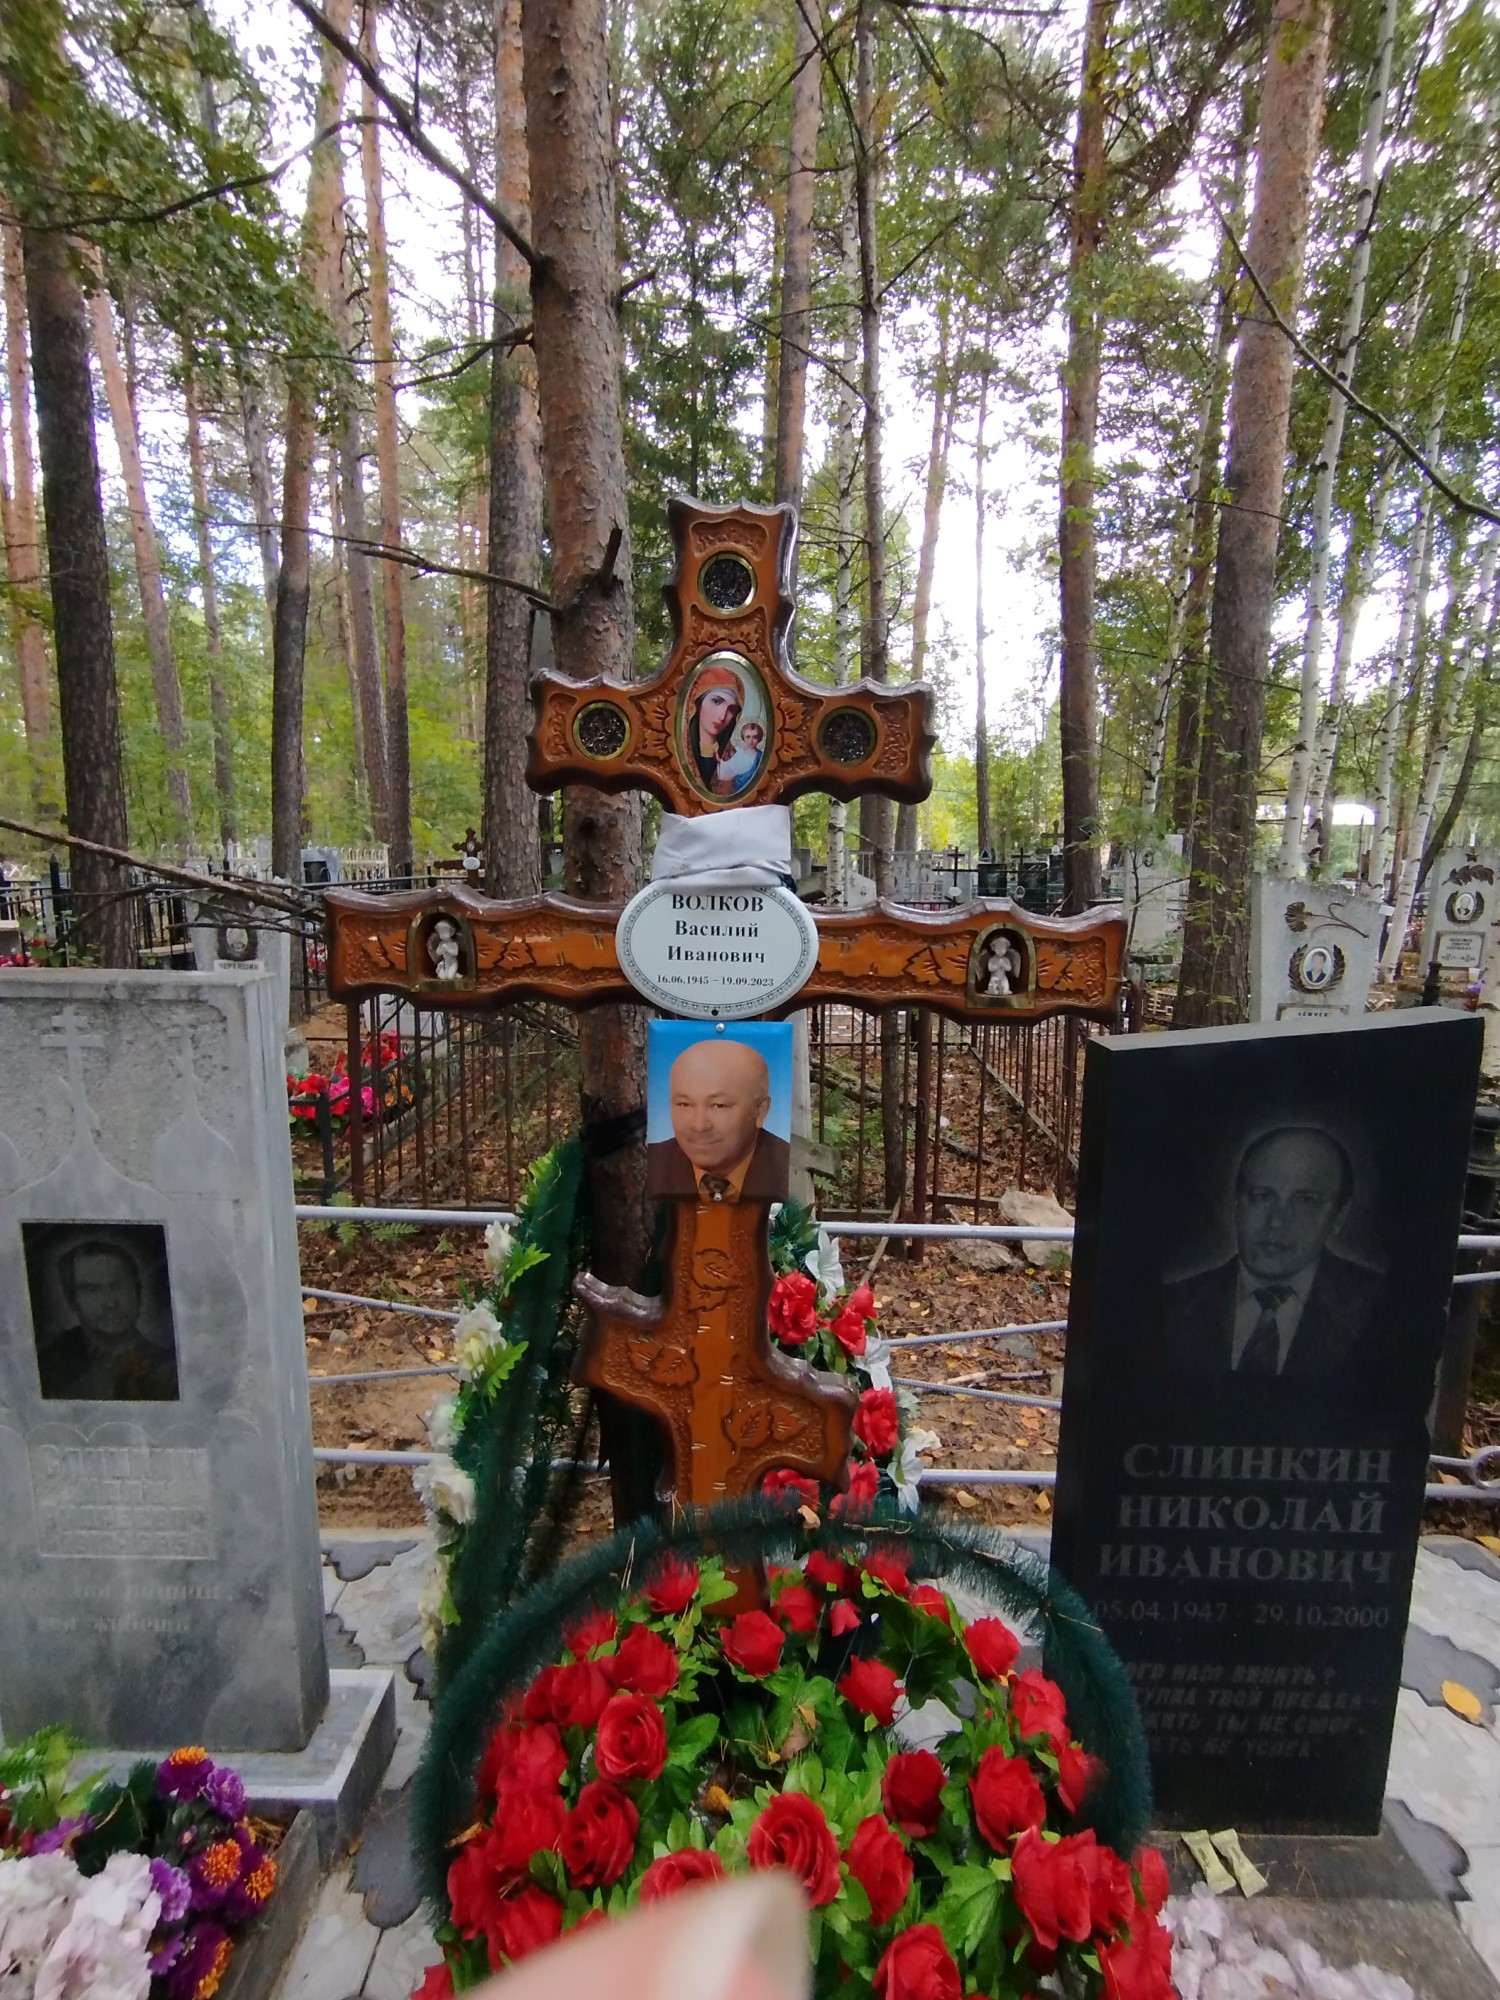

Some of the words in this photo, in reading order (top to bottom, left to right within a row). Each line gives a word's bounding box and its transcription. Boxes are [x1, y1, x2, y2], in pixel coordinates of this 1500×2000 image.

[672, 894, 764, 912] ВОЛКОВ
[675, 920, 759, 938] Василий
[667, 945, 766, 963] Иванович
[657, 975, 709, 985] 16.06.1945
[721, 976, 774, 987] 19.09.2023
[1123, 1443, 1392, 1483] СЛИНКИН
[1117, 1491, 1388, 1533] НИКОЛАЙ
[1098, 1544, 1392, 1584] ИВАНОВИЧ
[1094, 1600, 1229, 1623] 05.04.1947
[1253, 1603, 1390, 1628] 29.10.2000
[1124, 1662, 1166, 1680] ОГО
